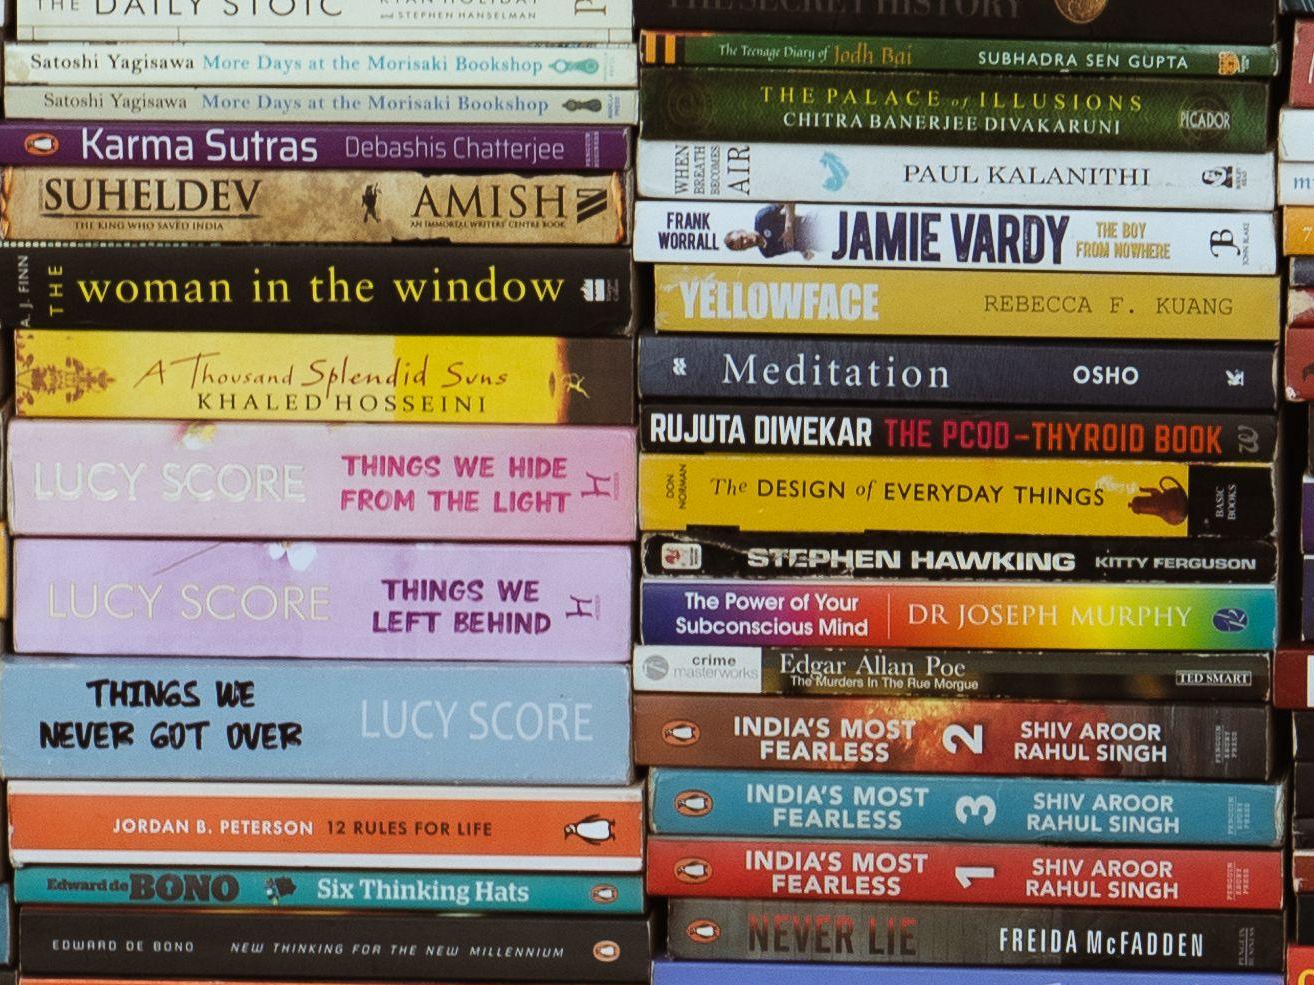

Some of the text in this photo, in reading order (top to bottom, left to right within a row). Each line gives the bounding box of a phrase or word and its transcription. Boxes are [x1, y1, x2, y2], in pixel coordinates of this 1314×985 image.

[202, 55, 543, 76] More Days at the Morisaki Bookshop
[978, 50, 1188, 70] SUBHADRA SEN GUPTA
[345, 135, 565, 166] Debashis Chatterjee
[902, 164, 1150, 187] PAUL KALANITHI
[1072, 365, 1139, 386] OSHO
[1095, 556, 1256, 571] KITTY FERGUSON
[779, 653, 966, 679] Edgar Allan Poe
[790, 674, 979, 692] The Murders In The Rue Morgue
[1178, 671, 1249, 685] TED SMART
[112, 817, 313, 836] JORDAN B. PETERSON
